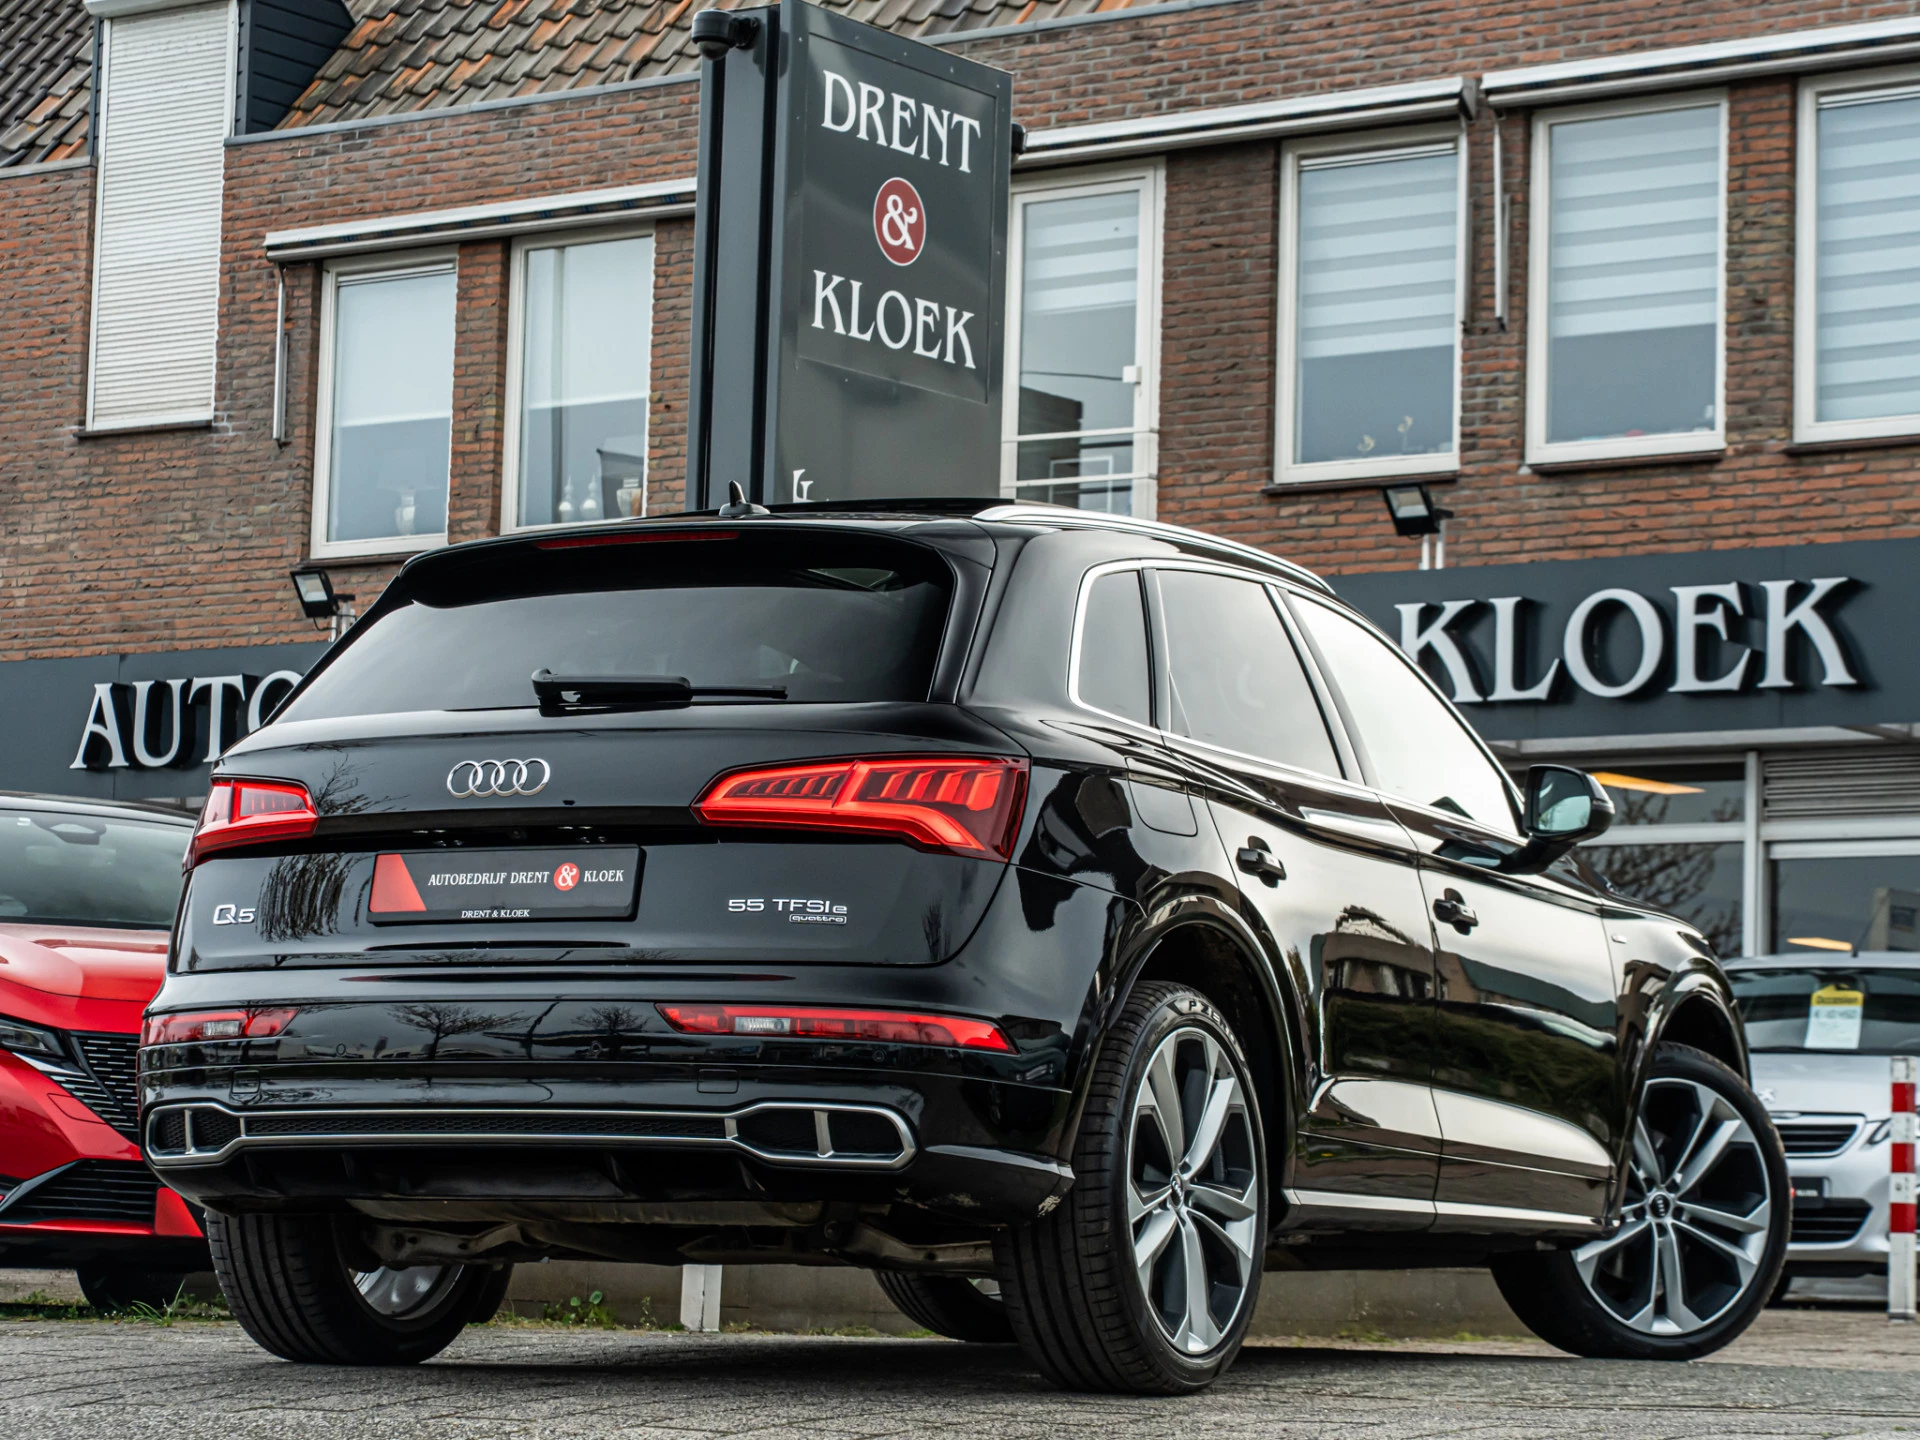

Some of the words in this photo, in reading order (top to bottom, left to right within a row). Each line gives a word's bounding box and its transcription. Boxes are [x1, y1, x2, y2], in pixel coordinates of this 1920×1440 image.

[820, 69, 981, 174] DRENT
[881, 194, 918, 251] &
[811, 269, 977, 370] KLOEK
[1394, 577, 1858, 704] KLOEK
[427, 872, 508, 887] AUTOBEDRIJF
[509, 871, 550, 885] DRENT
[557, 865, 577, 887] &
[583, 869, 625, 883] KLOEK
[213, 904, 256, 925] Q5
[461, 910, 491, 919] DRENT
[491, 910, 499, 918] &
[499, 909, 531, 918] KLOEK
[727, 898, 765, 912] 55
[790, 914, 845, 923] quattro
